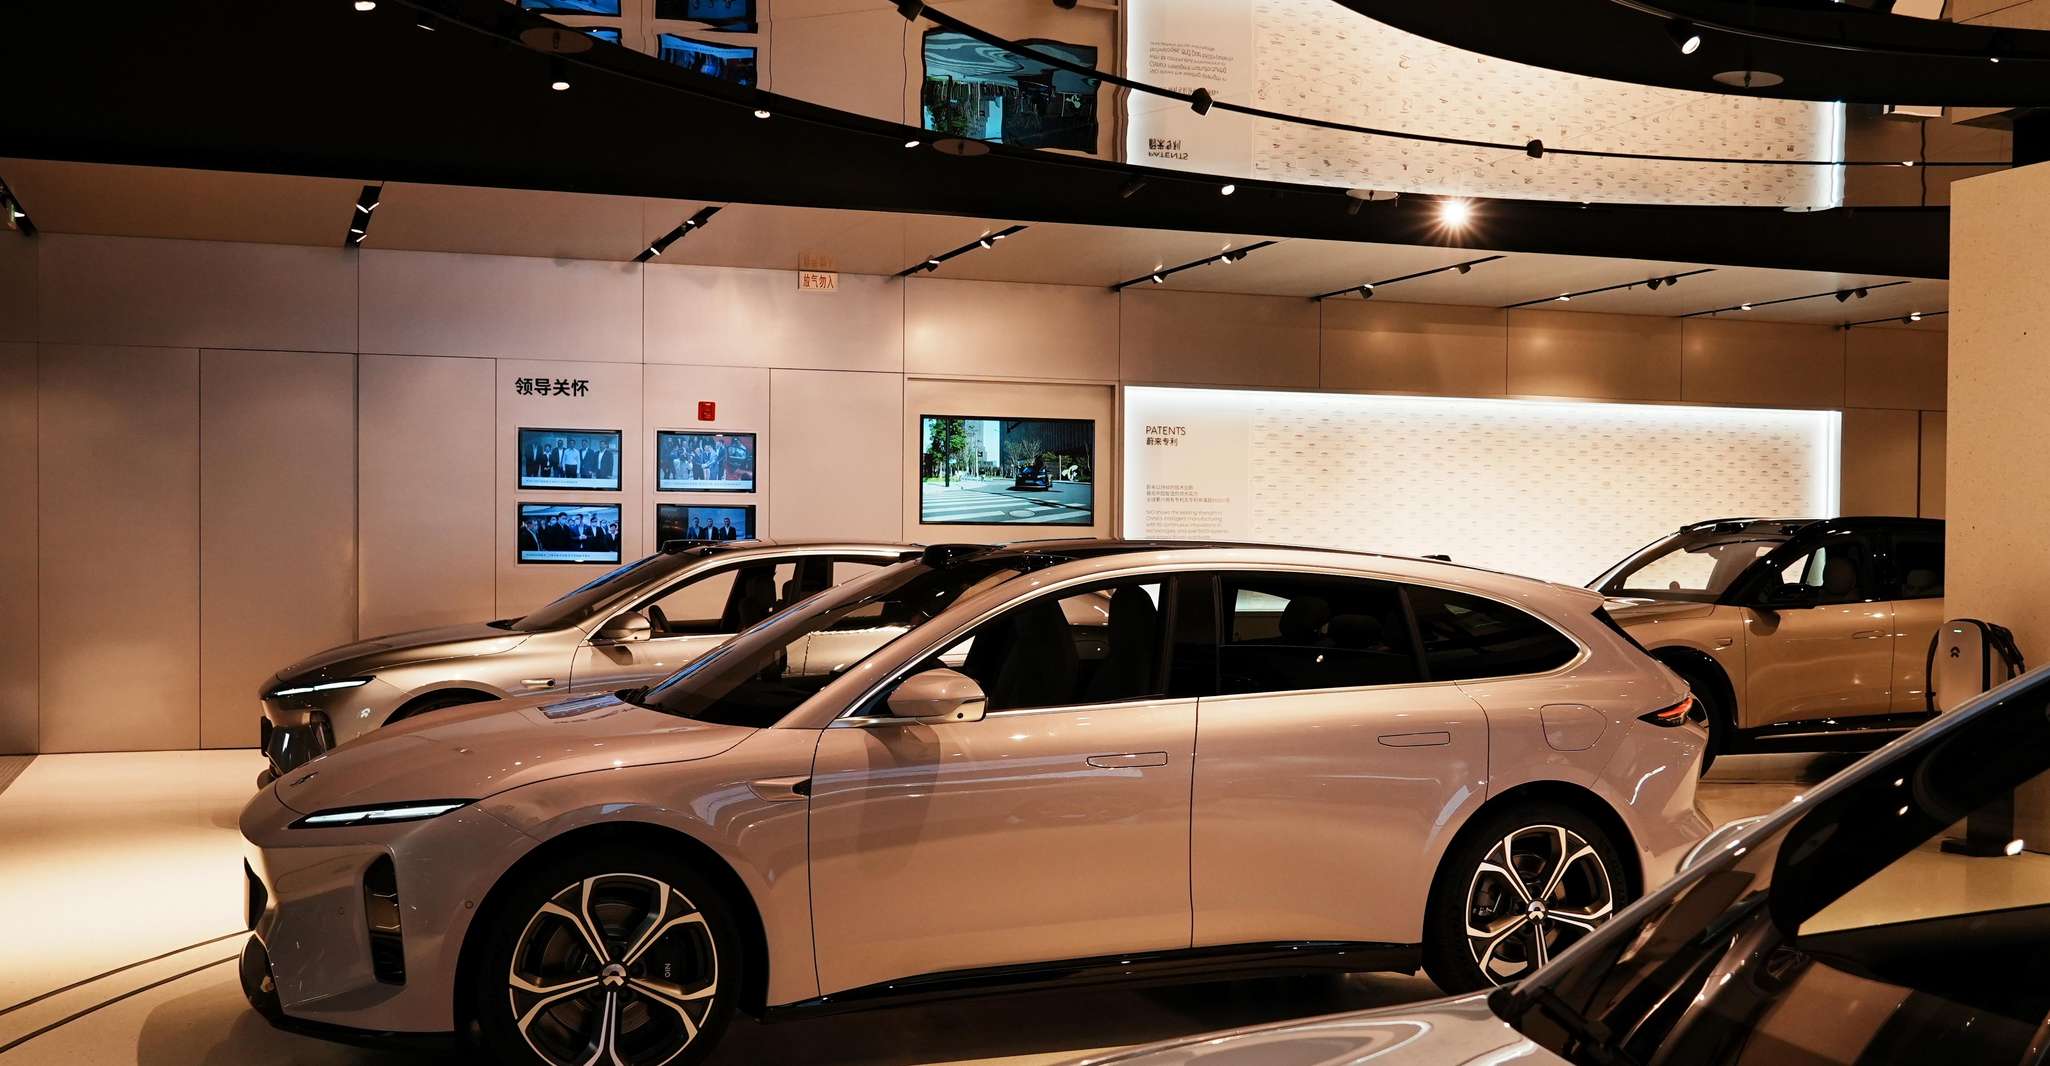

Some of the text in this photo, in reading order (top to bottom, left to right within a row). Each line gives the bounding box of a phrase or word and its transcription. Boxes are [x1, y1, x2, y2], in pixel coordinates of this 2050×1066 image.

[515, 377, 589, 397] 领导关怀
[1145, 425, 1186, 435] PATENTS
